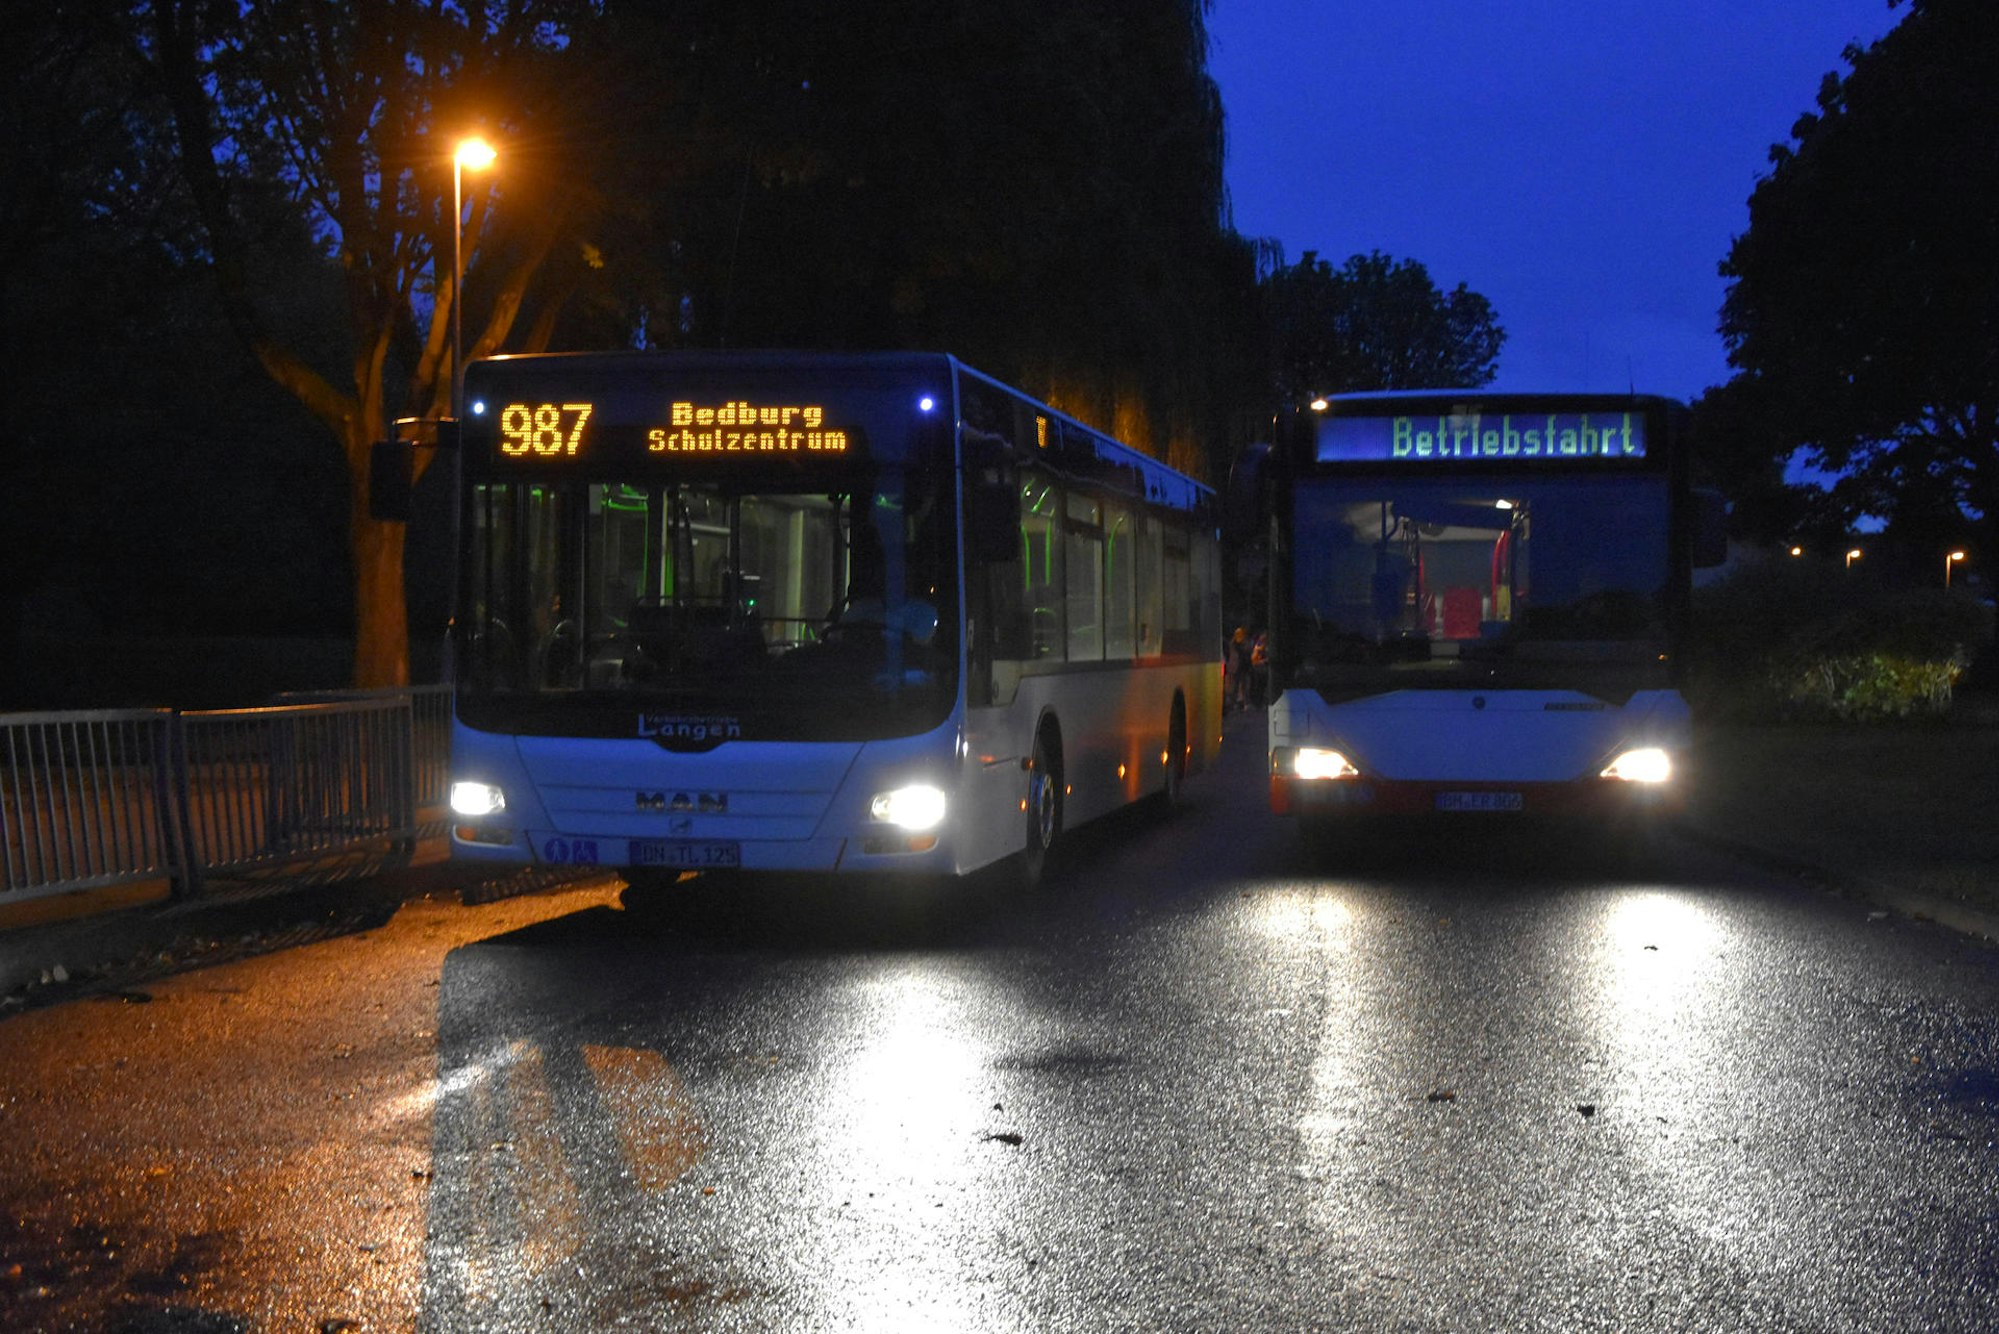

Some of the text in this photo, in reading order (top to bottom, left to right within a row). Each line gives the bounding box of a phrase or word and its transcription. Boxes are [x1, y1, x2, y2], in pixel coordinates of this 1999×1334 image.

[672, 402, 822, 427] Bedburg
[501, 403, 592, 455] 987
[648, 429, 846, 451] Schulzentrum
[1393, 413, 1635, 457] Betriebsfahrt
[638, 713, 740, 741] Langen
[636, 791, 727, 810] MAN
[704, 847, 736, 863] 125
